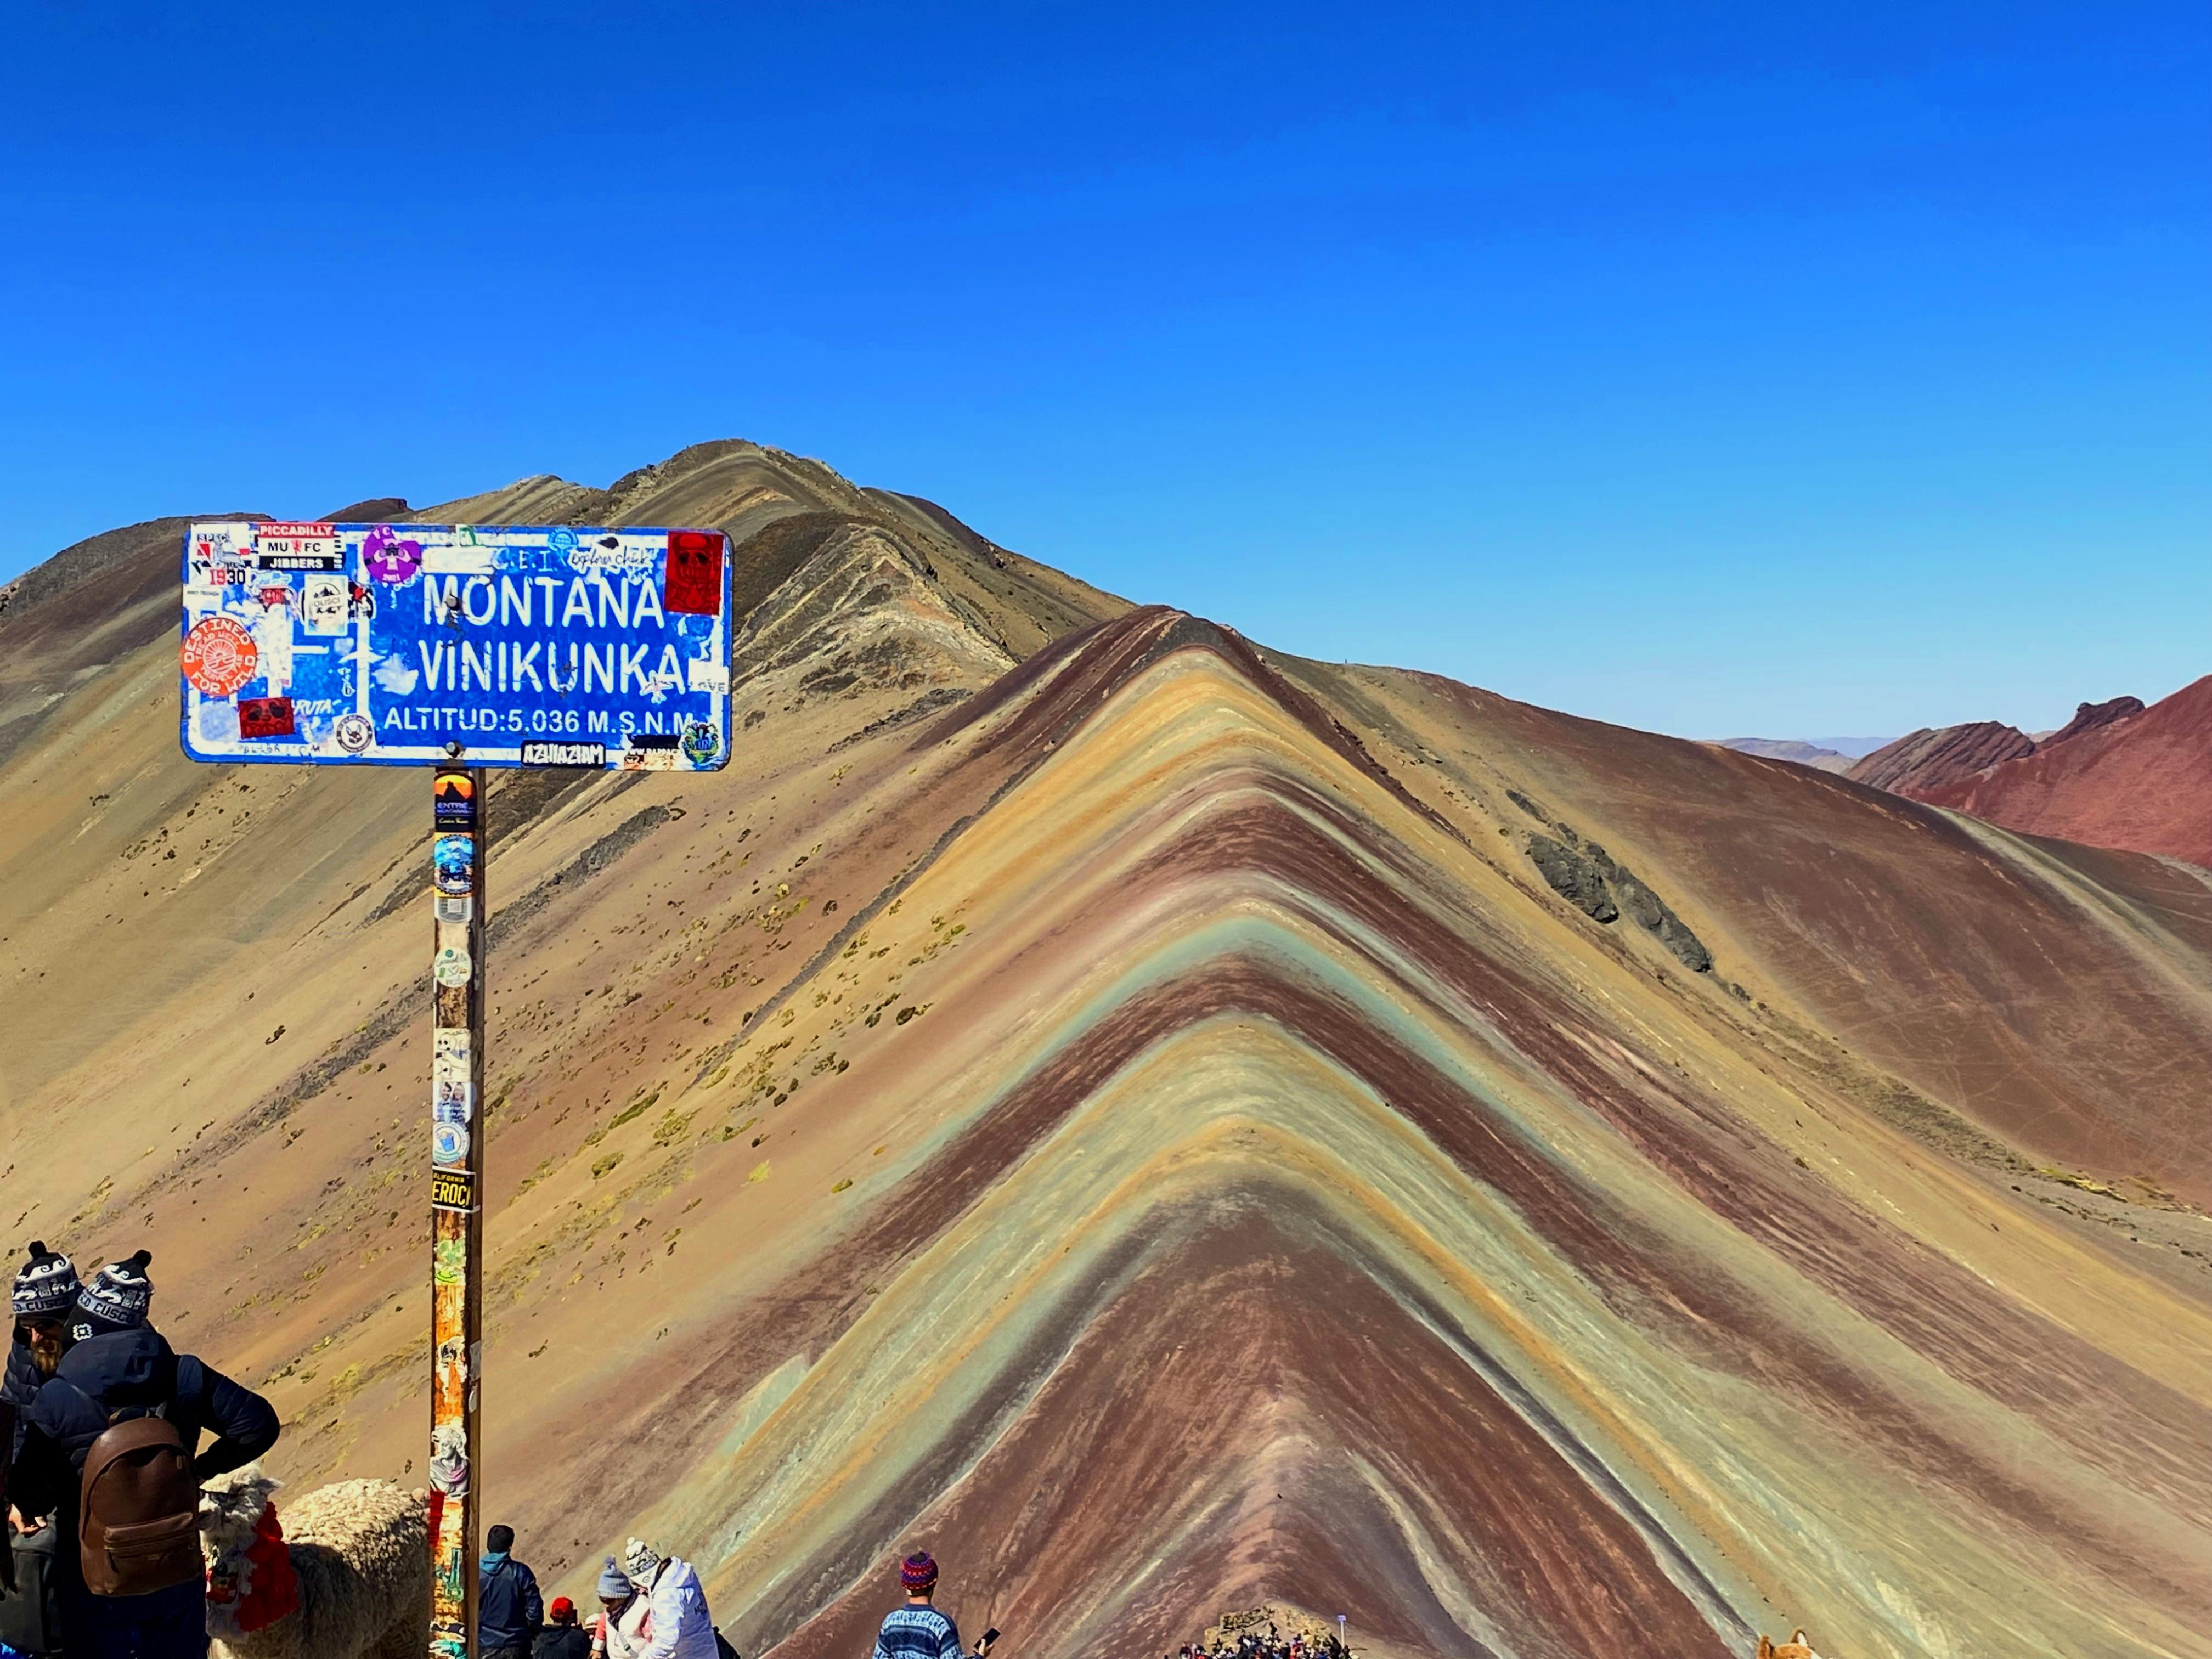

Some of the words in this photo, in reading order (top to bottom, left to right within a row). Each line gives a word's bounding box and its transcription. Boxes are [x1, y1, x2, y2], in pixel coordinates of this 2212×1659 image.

[259, 525, 333, 536] PICCADILLY
[268, 542, 288, 552] MU
[304, 543, 321, 552] FC
[269, 558, 324, 569] JIBBERS
[210, 569, 246, 585] 1930
[184, 619, 251, 663] DESTINED
[191, 671, 221, 694] FOR
[225, 655, 256, 693] WILD
[418, 640, 685, 695] VINIKUNKA
[294, 699, 332, 715] RUTA
[433, 1172, 465, 1183] ALIFORNIA
[26, 1296, 70, 1312] CUSCO
[93, 1302, 136, 1323] CUSCO
